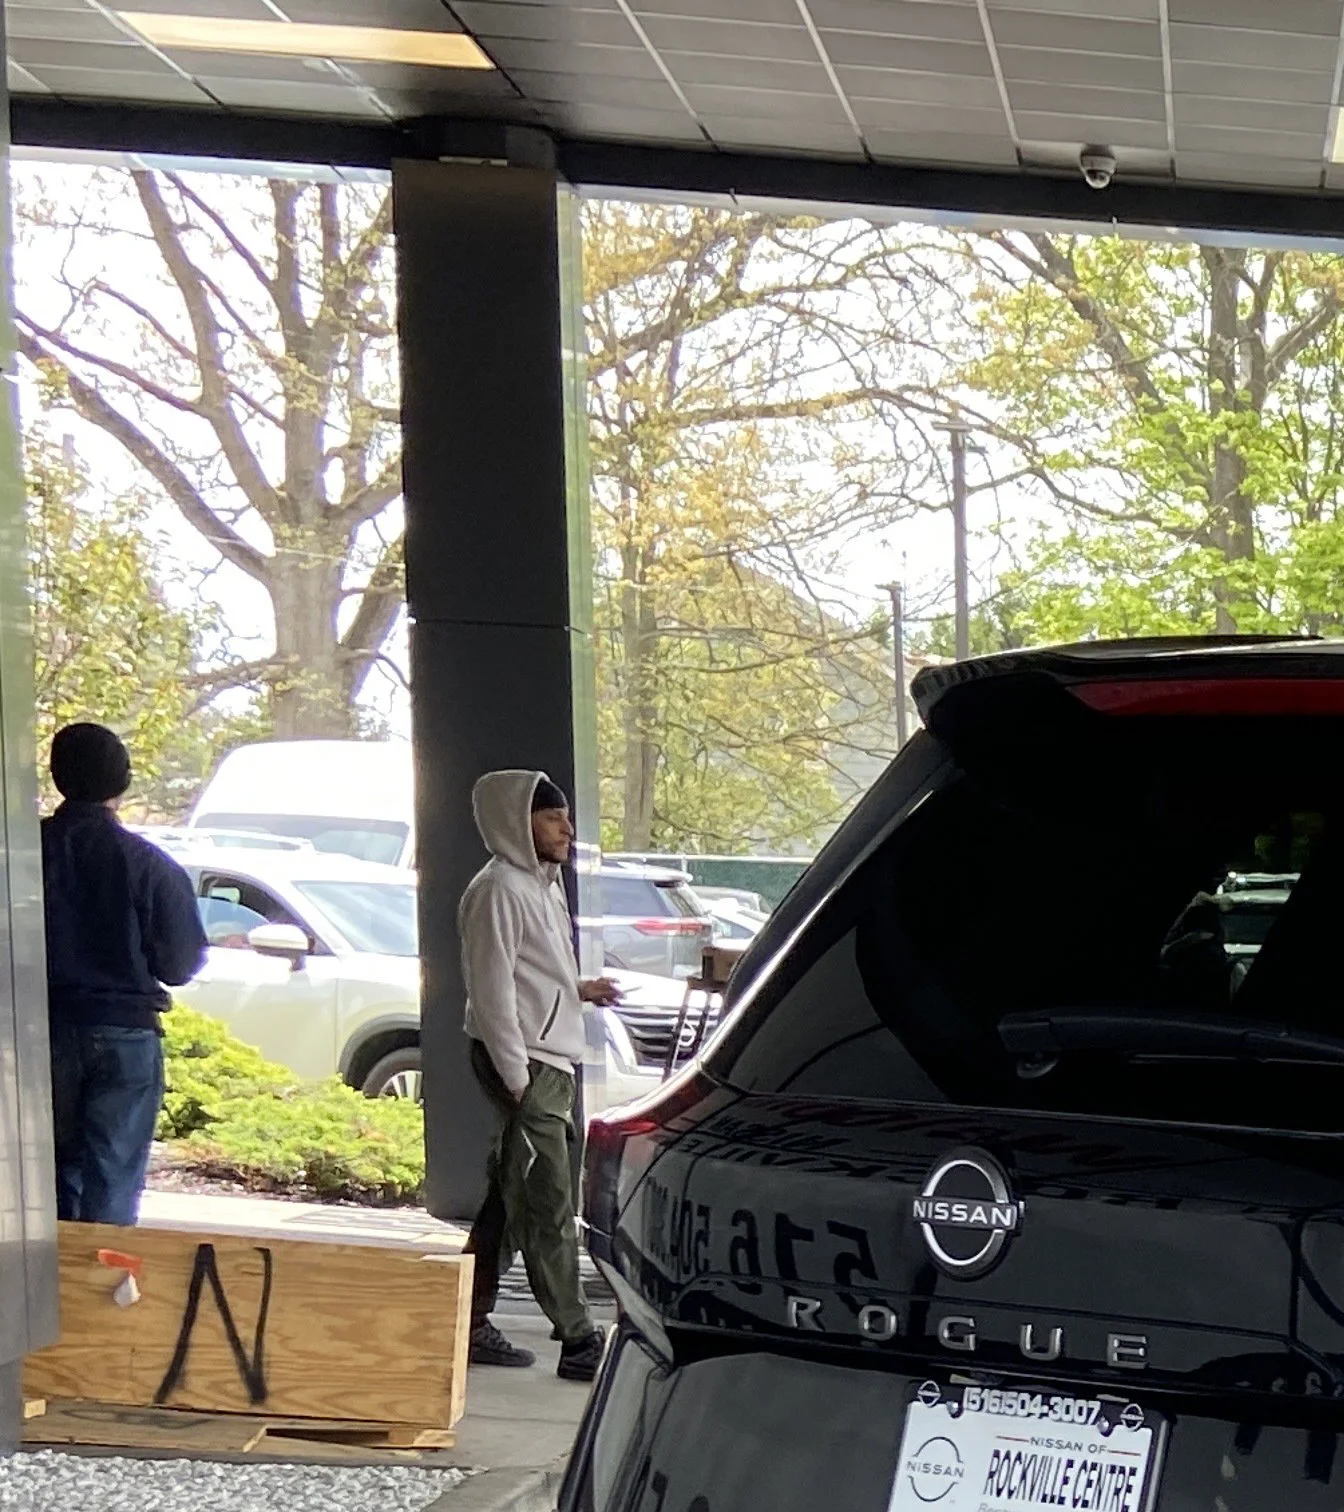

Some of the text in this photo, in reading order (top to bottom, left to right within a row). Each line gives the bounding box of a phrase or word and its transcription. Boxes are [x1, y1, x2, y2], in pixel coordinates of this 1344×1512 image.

[913, 1199, 1017, 1228] NISSAN
[787, 1296, 1149, 1369] ROGUE
[1030, 1436, 1108, 1454] NISSAN OF
[906, 1460, 965, 1478] NISSAN
[984, 1449, 1074, 1505] ROCKVILLE
